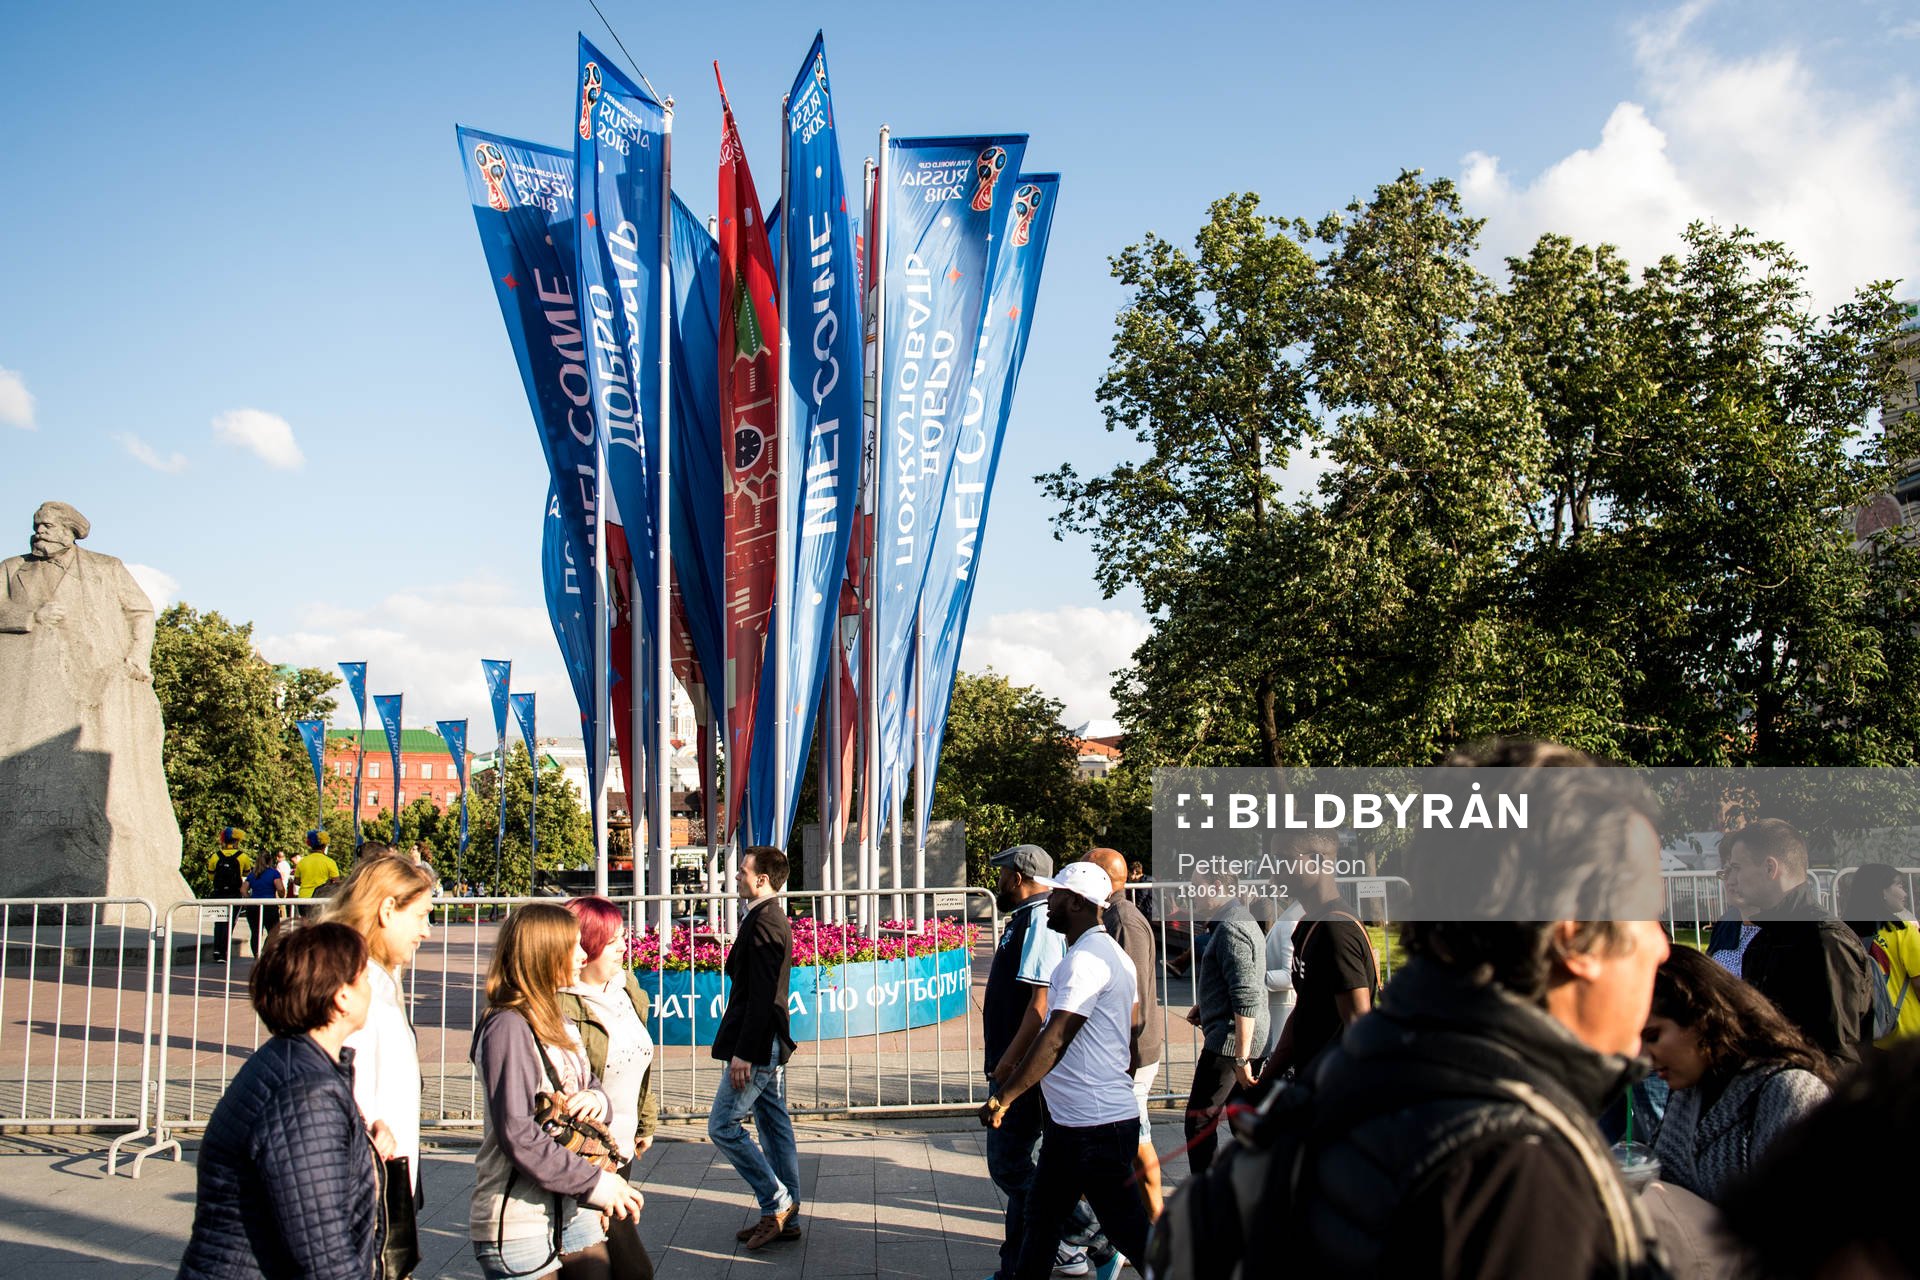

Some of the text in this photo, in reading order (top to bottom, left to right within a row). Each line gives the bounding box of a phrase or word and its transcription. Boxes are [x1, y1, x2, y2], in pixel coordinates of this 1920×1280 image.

[597, 121, 630, 156] 2018
[600, 101, 650, 152] RUSSIA
[518, 190, 559, 213] 2018
[588, 284, 641, 454] ДОБРО
[818, 986, 858, 1013] ПО
[866, 970, 957, 1007] ФУТБОЛУ
